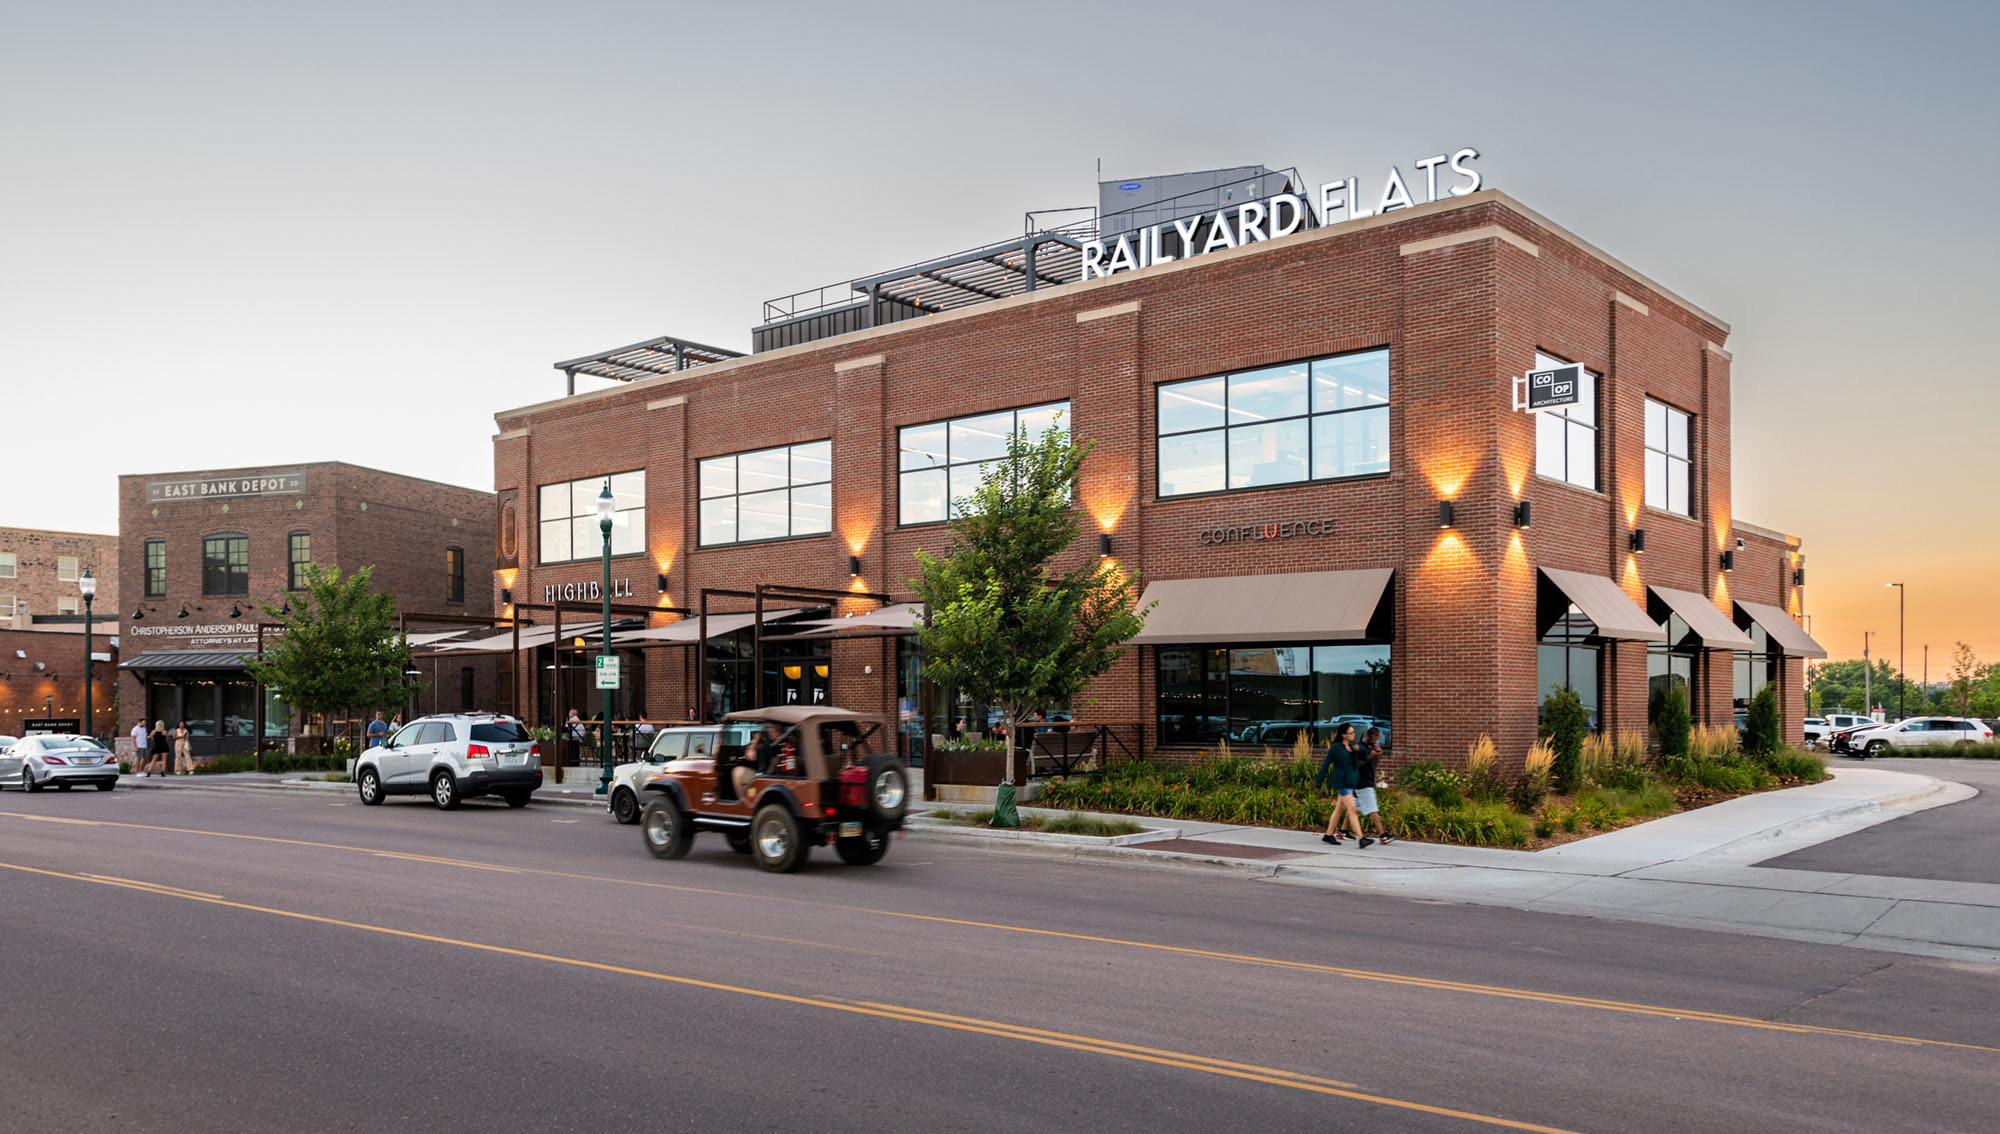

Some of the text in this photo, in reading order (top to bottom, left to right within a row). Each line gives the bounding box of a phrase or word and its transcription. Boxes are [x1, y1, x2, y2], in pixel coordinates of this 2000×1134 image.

[1081, 147, 1482, 281] RAILYARD FLATS
[1536, 375, 1551, 385] CO
[1554, 384, 1570, 394] OP
[1532, 397, 1574, 406] ARCHITECTURE
[164, 484, 196, 497] EAST
[200, 480, 237, 495] BANK
[241, 478, 286, 492] DEPOT
[1199, 518, 1336, 544] CONFLUENCE
[544, 577, 633, 603] HIGHBLL
[130, 625, 193, 636] CHRISTOPHERSON
[194, 624, 235, 634] ANDERSON
